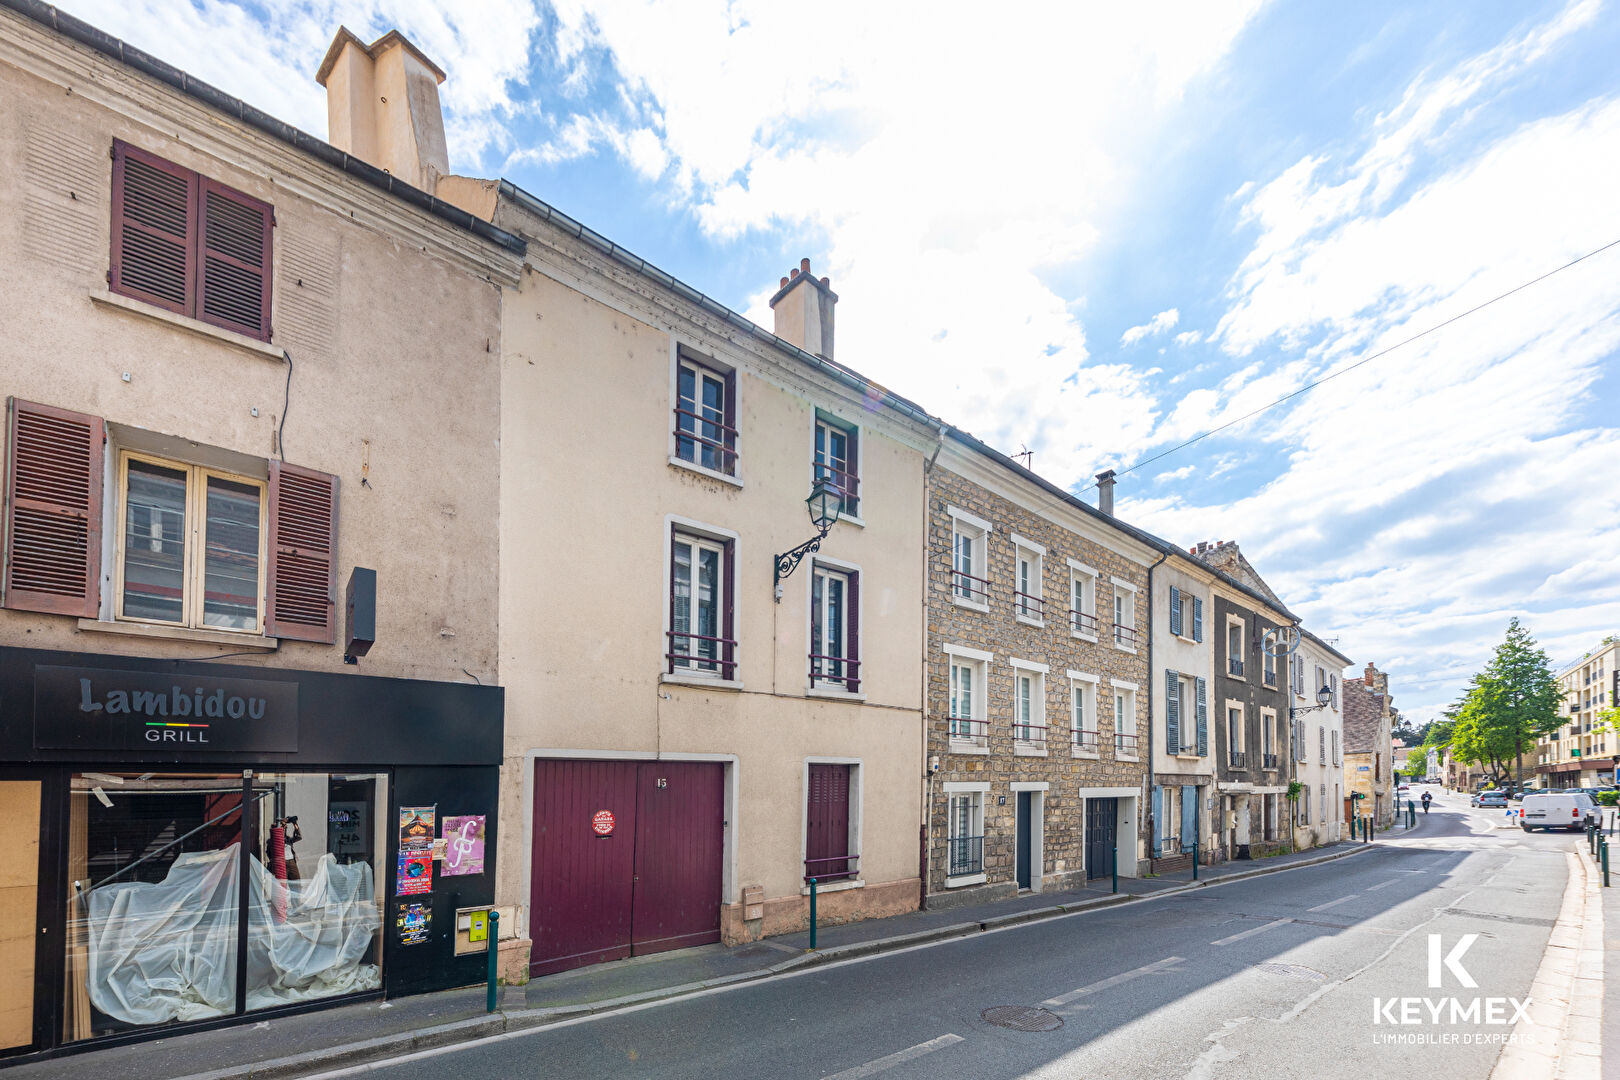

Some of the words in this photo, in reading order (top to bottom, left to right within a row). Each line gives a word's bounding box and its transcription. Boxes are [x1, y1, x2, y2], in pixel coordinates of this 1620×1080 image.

[80, 678, 267, 720] Lambidou
[145, 729, 209, 743] GRILL
[657, 778, 667, 788] 15
